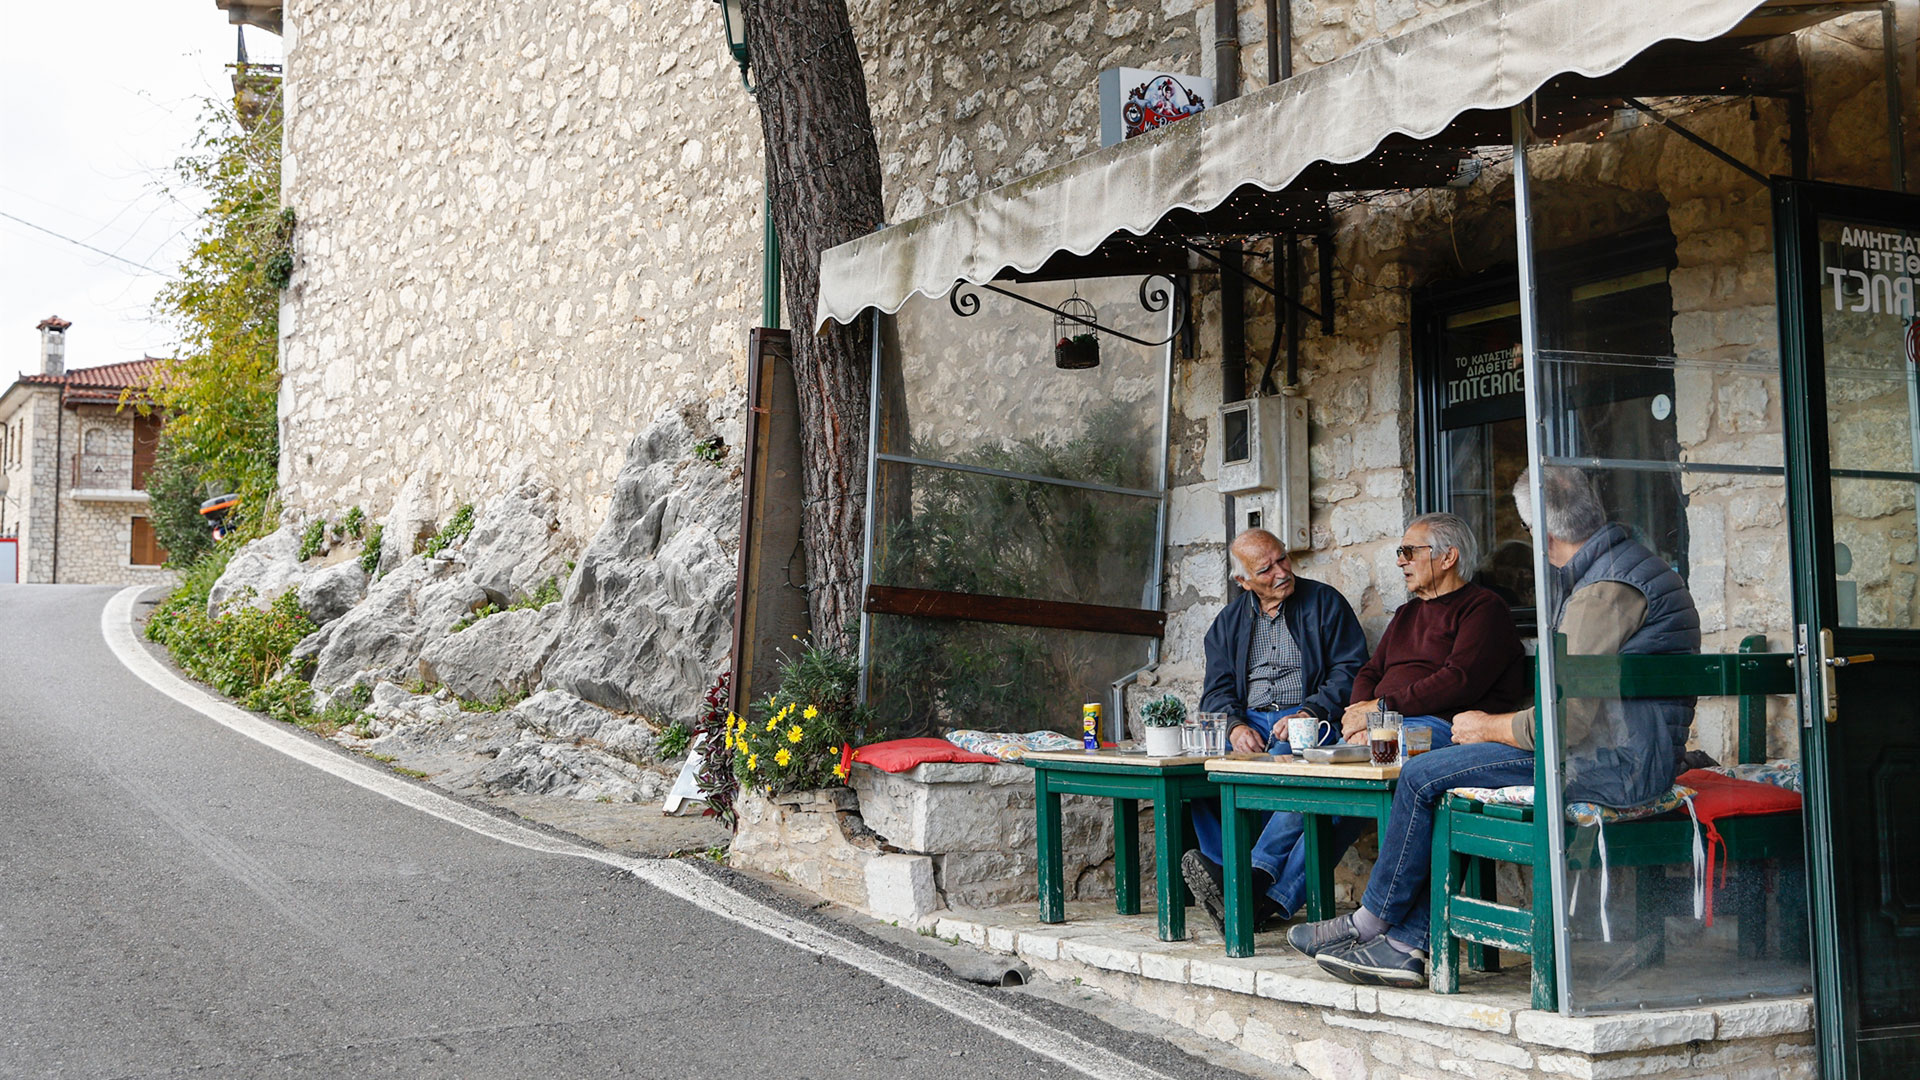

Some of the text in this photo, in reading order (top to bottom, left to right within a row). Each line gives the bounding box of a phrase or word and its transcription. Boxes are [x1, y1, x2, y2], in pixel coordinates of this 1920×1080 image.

[1455, 347, 1521, 368] ΤΟ ΚΑΤΑΣΤΗΜ
[1467, 358, 1517, 377] ΔΙΑΘΕΤΕΙ
[1449, 369, 1525, 404] INTERNE
